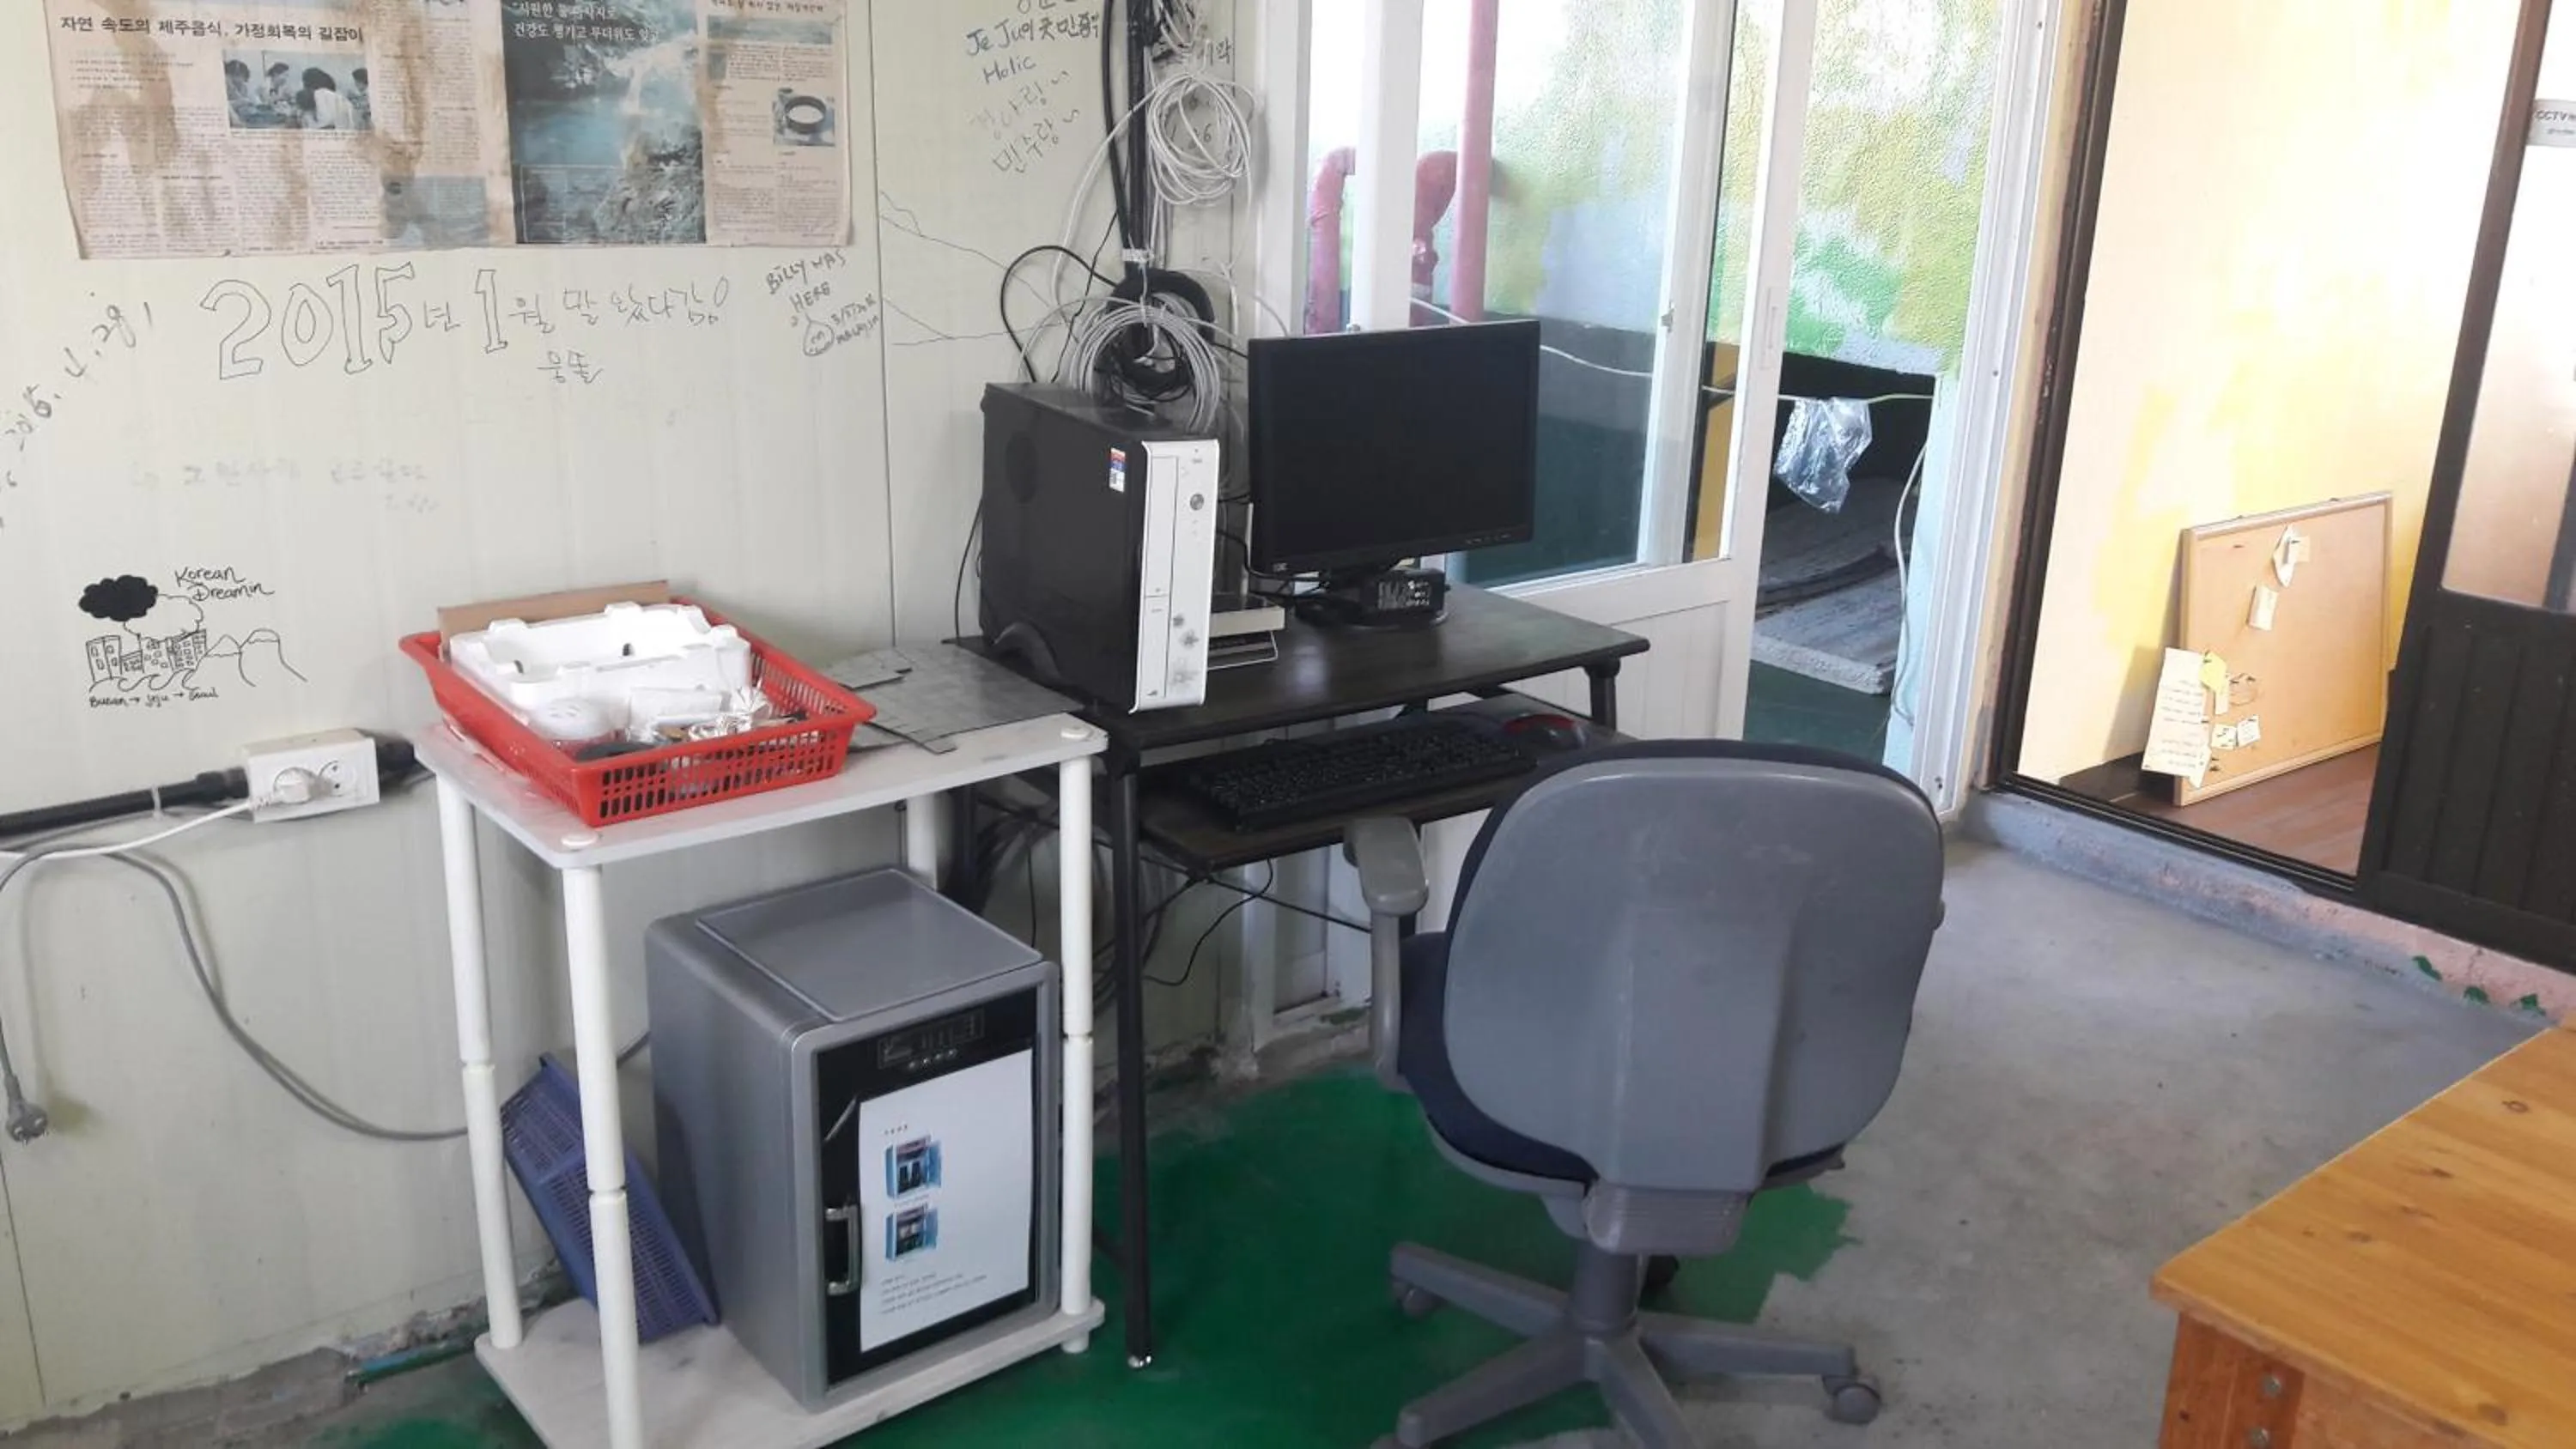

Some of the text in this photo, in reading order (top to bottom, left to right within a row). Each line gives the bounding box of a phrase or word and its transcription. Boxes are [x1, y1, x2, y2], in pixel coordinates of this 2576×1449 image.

[60, 15, 93, 32] 자연
[101, 16, 150, 33] 속도의
[318, 26, 364, 44] 길잡이
[515, 21, 550, 39] 건강도
[2535, 110, 2568, 121] CCTV
[173, 566, 247, 588] Korean
